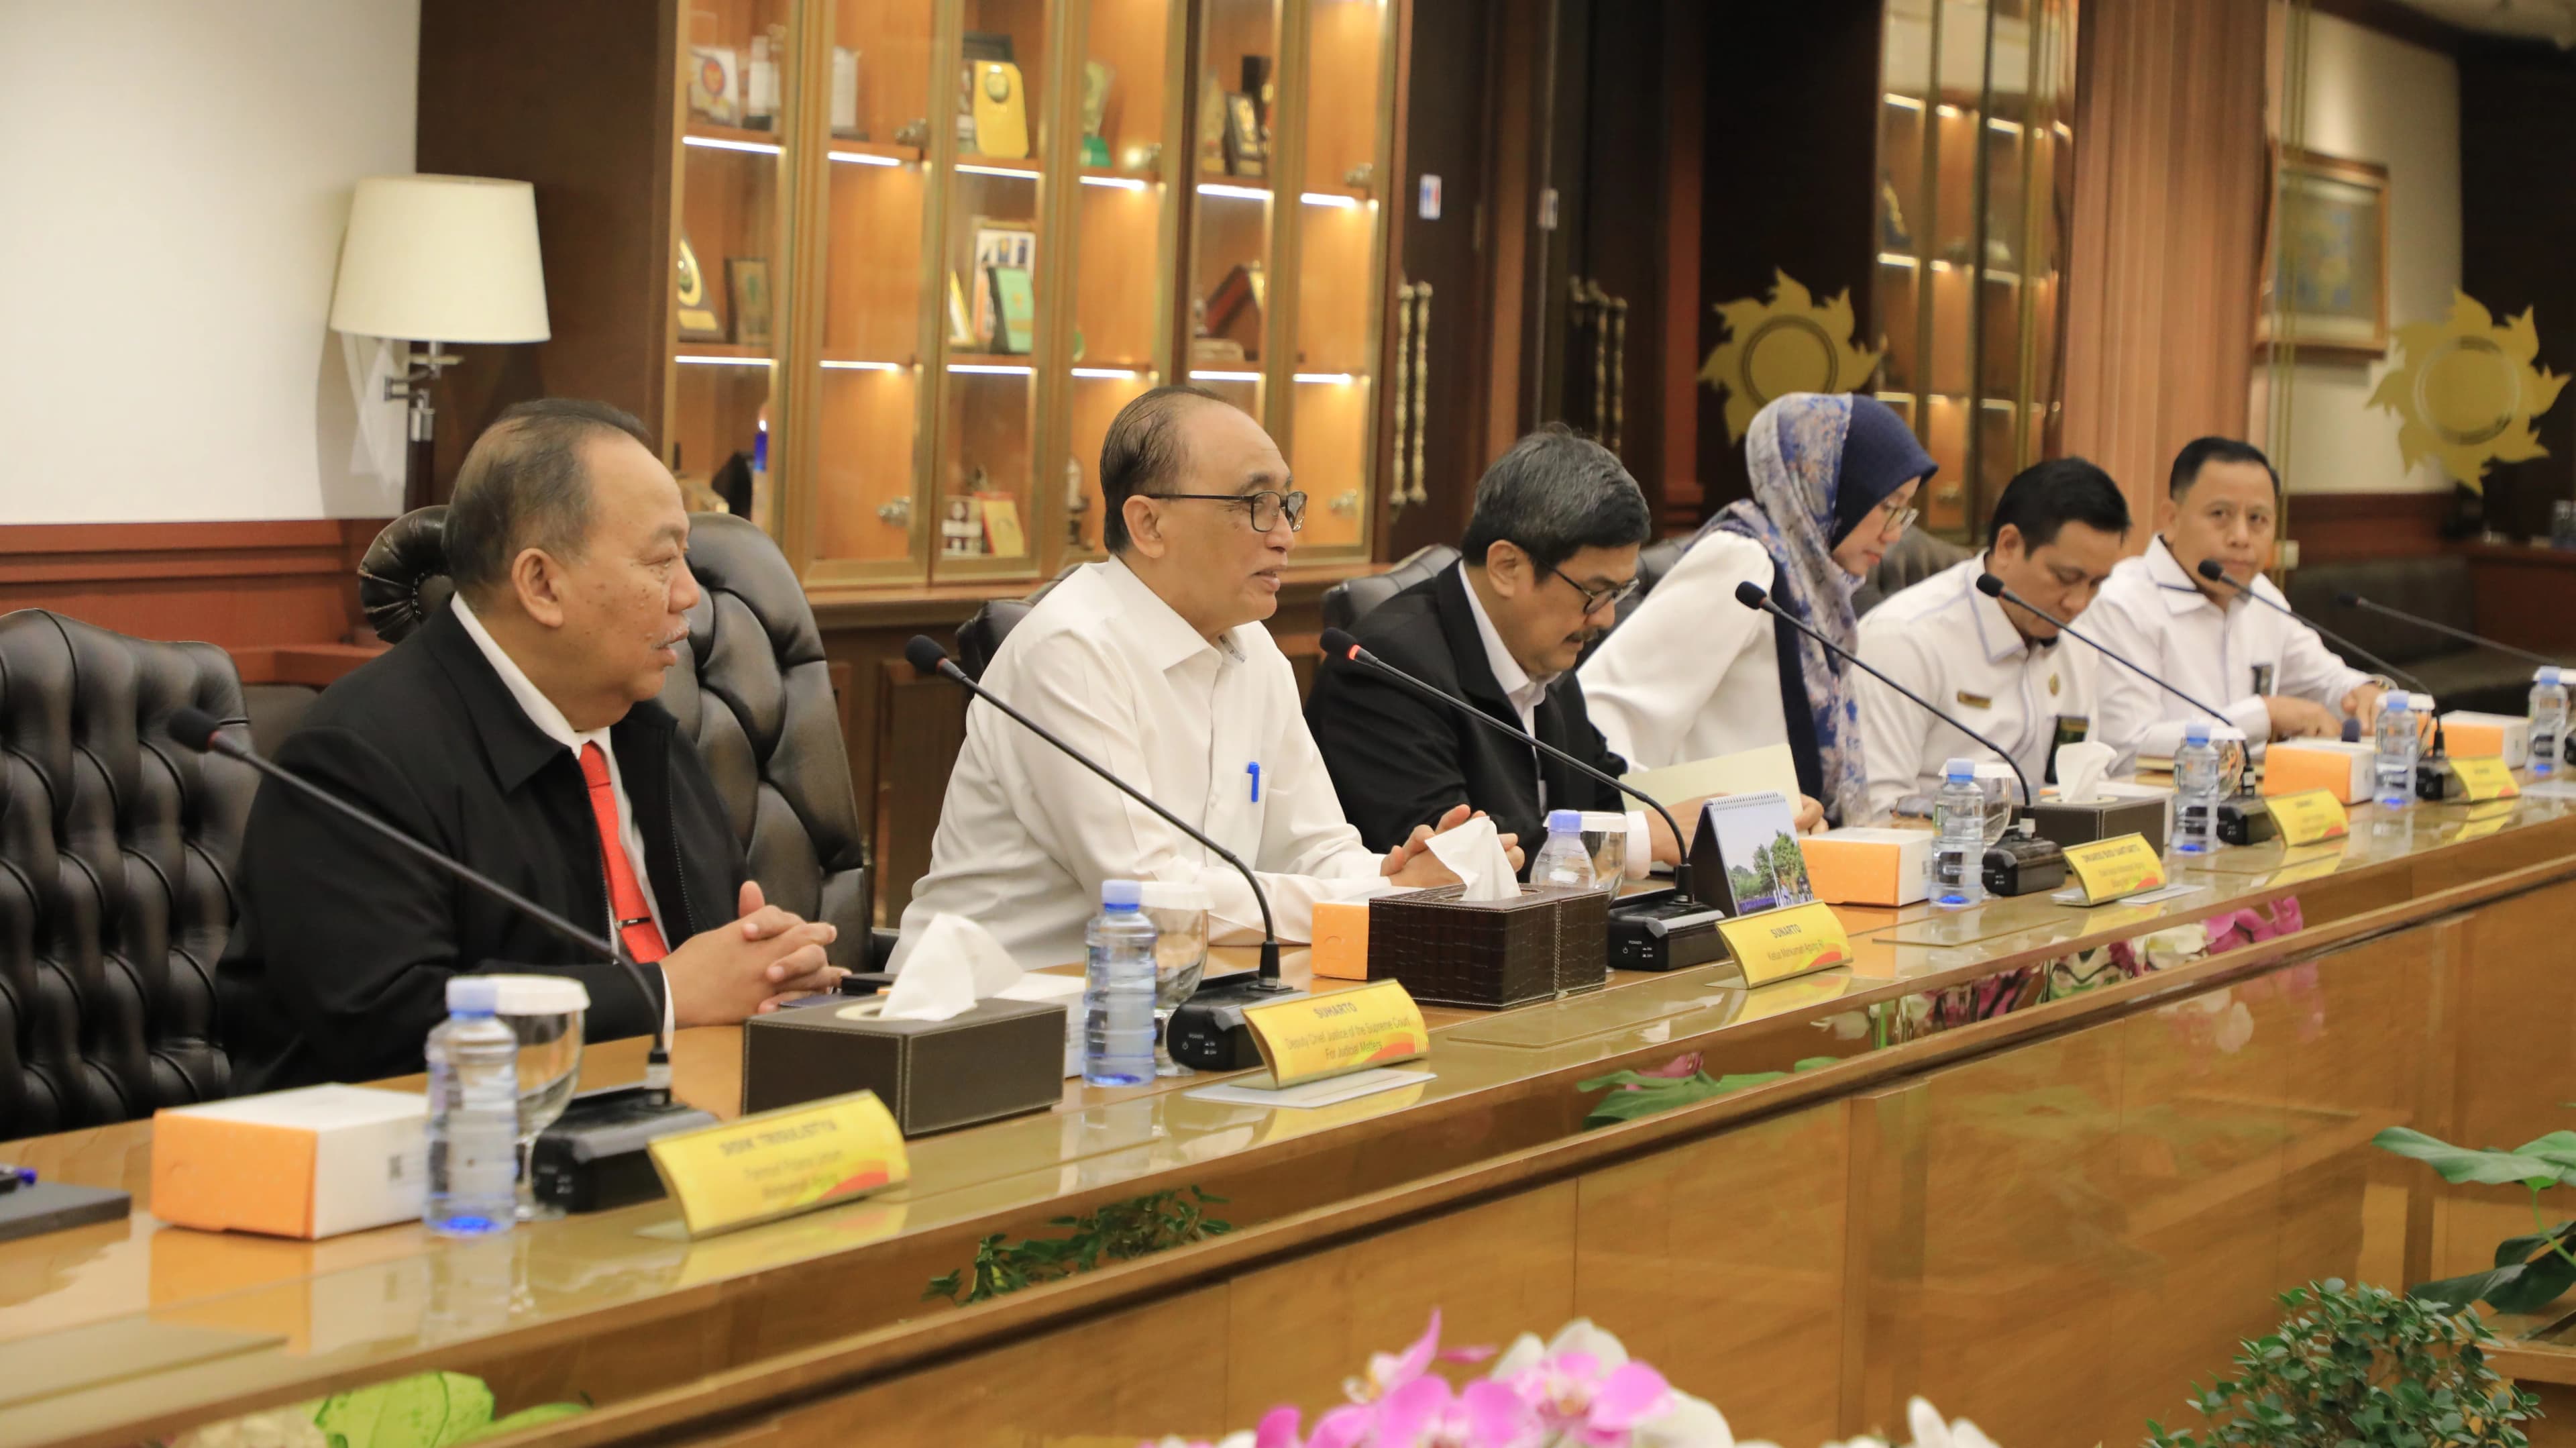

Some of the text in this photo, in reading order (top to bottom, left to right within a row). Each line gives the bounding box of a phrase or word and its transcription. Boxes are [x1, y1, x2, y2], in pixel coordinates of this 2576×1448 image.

[1770, 924, 1802, 939] SUNARTO
[1307, 1031, 1326, 1046] Chief
[1354, 1024, 1366, 1035] the
[1364, 1021, 1393, 1036] Supreme
[1391, 1017, 1411, 1028] Court
[1326, 1047, 1337, 1059] For
[1359, 1040, 1383, 1053] Matters
